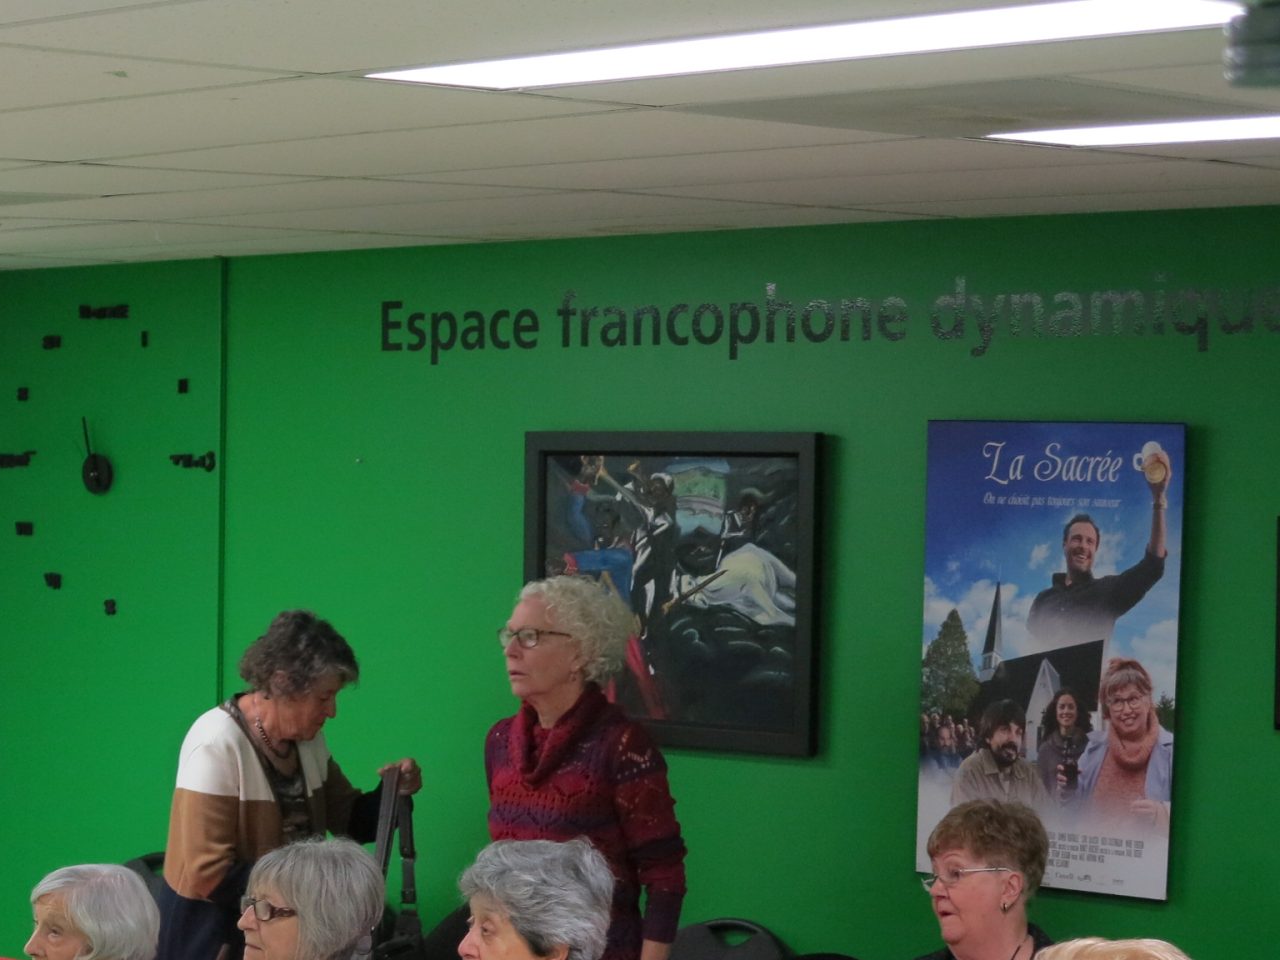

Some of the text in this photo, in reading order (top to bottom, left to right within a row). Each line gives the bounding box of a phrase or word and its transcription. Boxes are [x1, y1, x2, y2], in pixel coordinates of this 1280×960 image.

[380, 301, 539, 366] Espace
[557, 283, 912, 361] francophone
[982, 440, 1124, 485] La Sacrée
